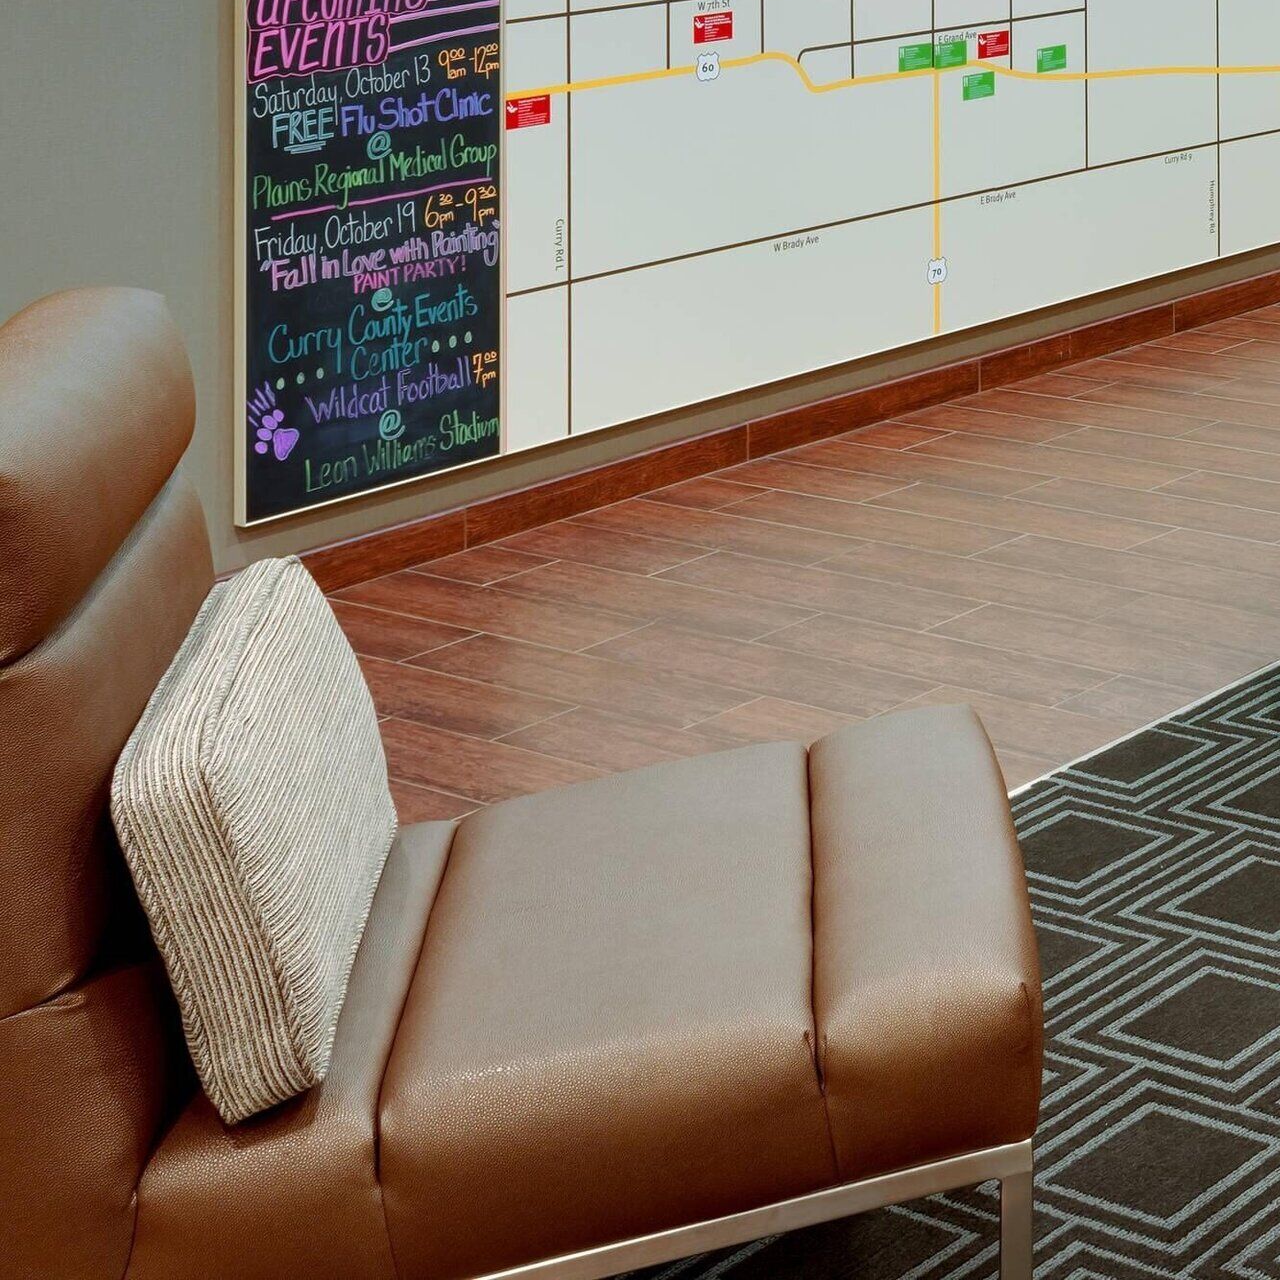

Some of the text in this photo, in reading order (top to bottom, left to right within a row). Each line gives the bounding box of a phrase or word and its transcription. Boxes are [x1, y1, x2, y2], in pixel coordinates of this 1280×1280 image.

[254, 14, 386, 77] EVENTS
[701, 63, 714, 73] 60
[253, 54, 432, 126] Saturday, October 13
[271, 106, 335, 149] FREE
[340, 103, 376, 137] Flu
[378, 93, 436, 130] Shot
[434, 88, 494, 122] Clinic
[253, 133, 498, 210] Plains Regional Medical Group
[366, 131, 392, 160] @
[254, 201, 416, 262] Friday, October 19
[321, 254, 340, 280] in
[342, 247, 387, 277] Love
[389, 236, 429, 265] with
[554, 218, 565, 247] Curry
[354, 255, 467, 294] PAINT PARTY!
[932, 268, 942, 278] 70
[268, 283, 478, 374] Curry County Events
[350, 335, 428, 381] Center
[304, 355, 472, 424] Wildcat Football
[305, 454, 358, 493] Leon
[440, 408, 500, 452] Stadium
